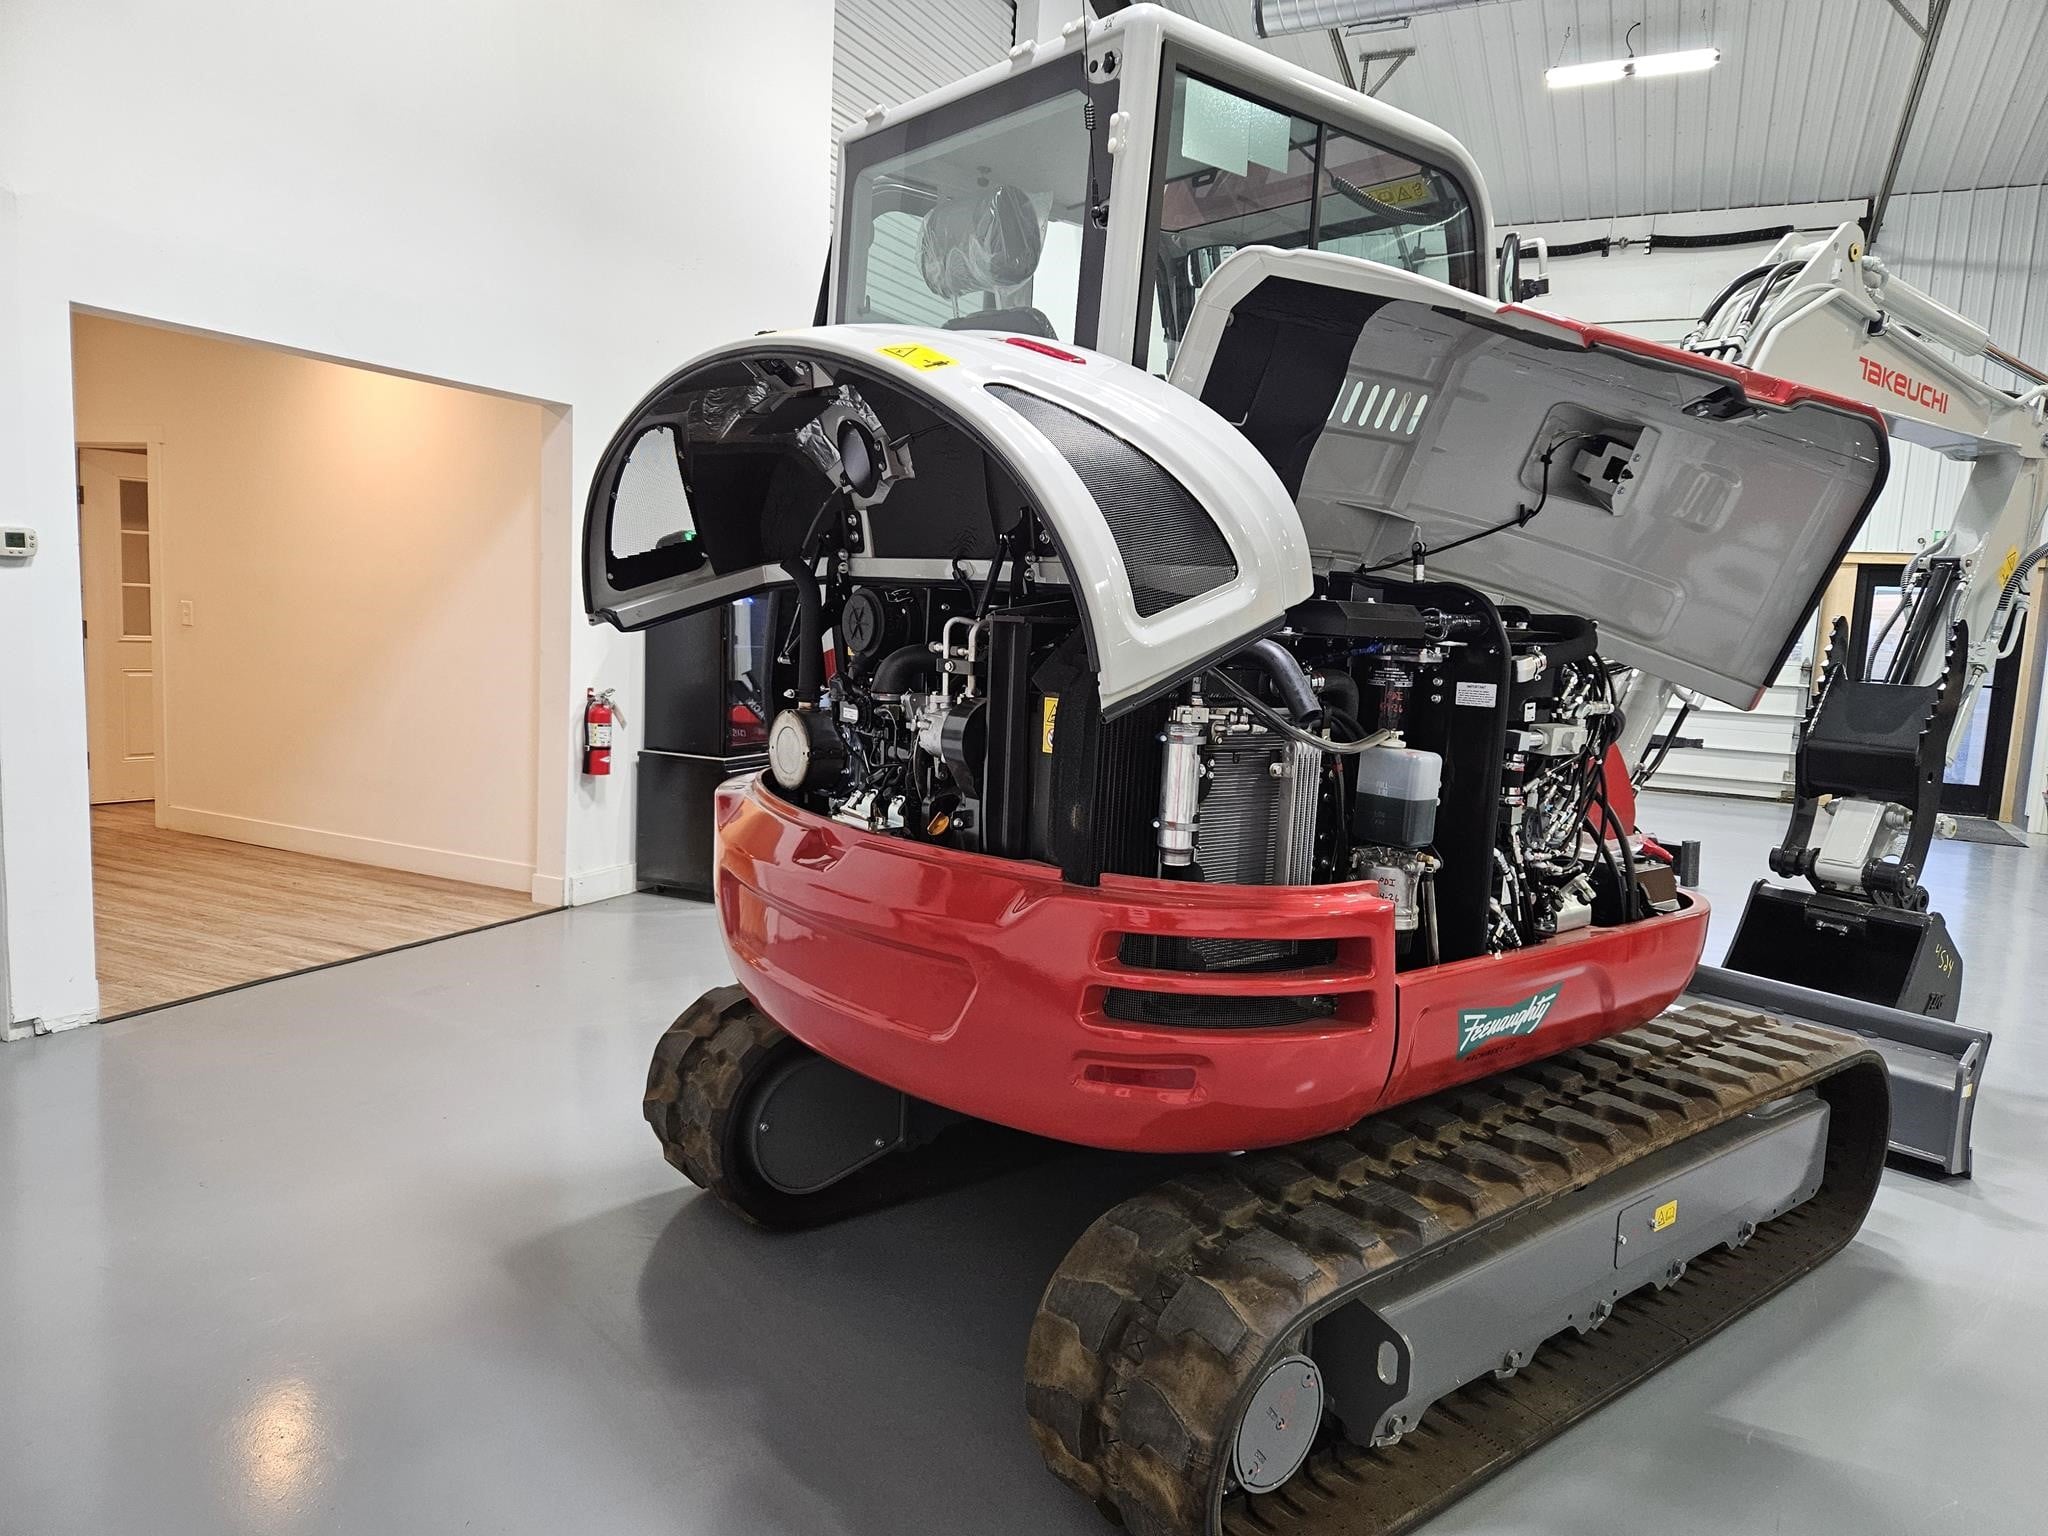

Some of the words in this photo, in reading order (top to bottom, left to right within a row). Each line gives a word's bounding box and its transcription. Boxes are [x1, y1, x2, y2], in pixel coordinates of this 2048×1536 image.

[1858, 356, 1949, 414] TAKEUCHI
[1379, 877, 1396, 887] PDI
[1460, 993, 1557, 1052] Feenaughty
